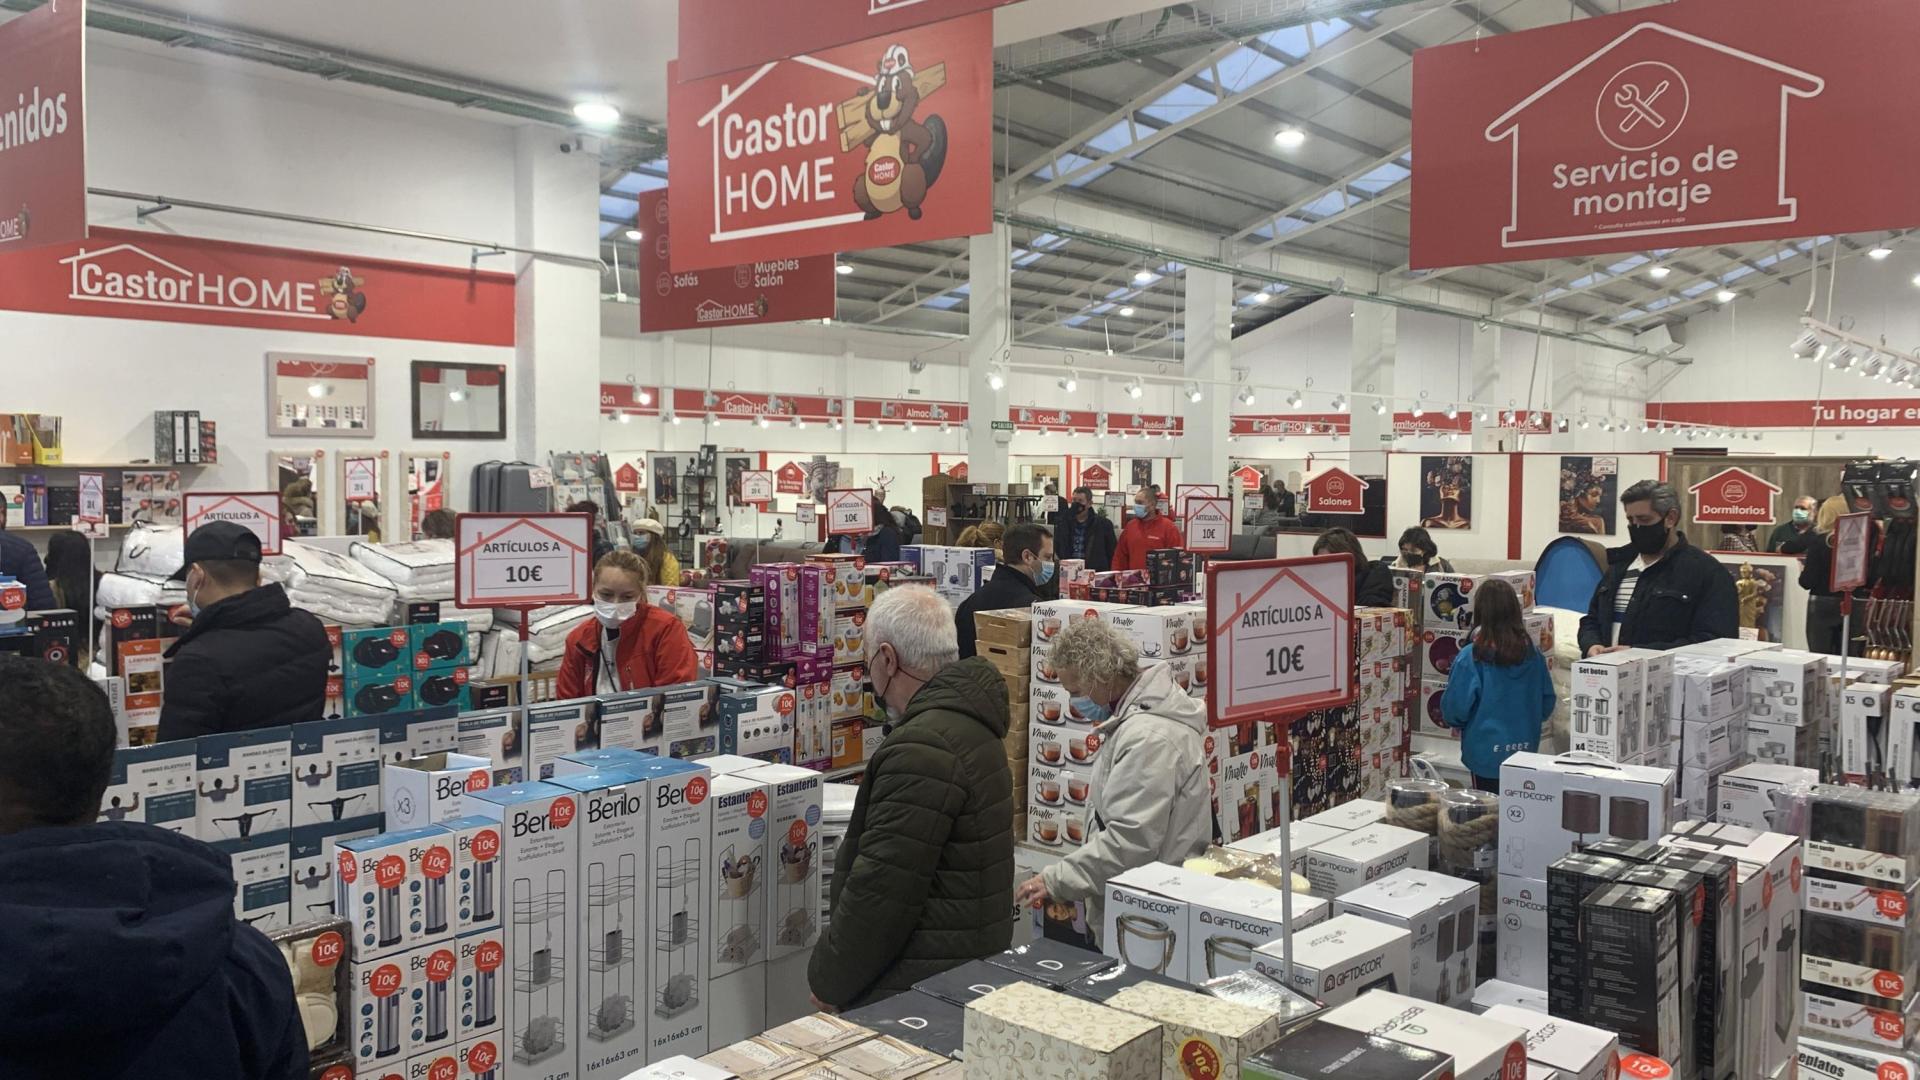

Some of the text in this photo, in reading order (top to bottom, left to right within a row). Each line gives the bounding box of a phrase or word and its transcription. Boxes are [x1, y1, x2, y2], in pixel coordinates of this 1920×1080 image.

[724, 102, 833, 160] Castor
[1552, 144, 1739, 190] Servicio de
[725, 156, 835, 215] HOME
[1573, 178, 1712, 216] montaje
[754, 259, 799, 273] Muebles
[80, 262, 316, 313] Castor HOME
[1812, 406, 1835, 421] Tu
[1840, 406, 1900, 423] hogar
[1318, 496, 1353, 507] Salones
[203, 510, 260, 521] ARTÍCULOS A
[1702, 504, 1766, 516] Dormitorios
[844, 514, 858, 523] 10€
[1202, 528, 1216, 539] 10€
[483, 540, 561, 554] ARTÍCULOS A
[505, 564, 543, 583] 10€
[1242, 604, 1324, 629] ARTÍCULOS A
[1265, 645, 1305, 676] 10€
[435, 776, 468, 800] Ber
[470, 778, 485, 788] 10€
[690, 785, 704, 795] 10€
[656, 783, 686, 808] Ber
[1504, 788, 1553, 803] GIFTDECOR
[587, 792, 640, 823] Berilo
[751, 799, 764, 808] 10€
[554, 806, 571, 817] 10€
[1510, 809, 1522, 819] X2
[475, 839, 496, 851] 10€
[342, 860, 354, 872] 10€
[427, 857, 447, 869] 10€
[380, 866, 401, 878] 10€
[1124, 894, 1177, 916] GIFTDECOR
[1882, 899, 1903, 911] 10€
[1213, 916, 1270, 937] GIFTDECOR
[1507, 917, 1518, 926] X2
[317, 943, 338, 956] 10€
[480, 951, 499, 962] 10€
[432, 959, 450, 972] 10€
[1336, 956, 1382, 988] GIFTDECOR
[376, 973, 397, 986] 10€
[1266, 966, 1312, 987] GIFTCOR
[1879, 979, 1900, 990] 10€
[1880, 1021, 1900, 1033] 10€
[653, 1024, 703, 1048] 16x16x63 cm
[475, 1049, 494, 1064] 10€
[586, 1047, 640, 1072] 16x16x63 cm
[1191, 1048, 1211, 1075] 10€
[434, 1065, 454, 1078] 10€
[1506, 1061, 1523, 1079] 10€
[1631, 1060, 1663, 1075] 10€
[1799, 1052, 1845, 1077] eplatos
[1884, 1069, 1904, 1080] 10€
